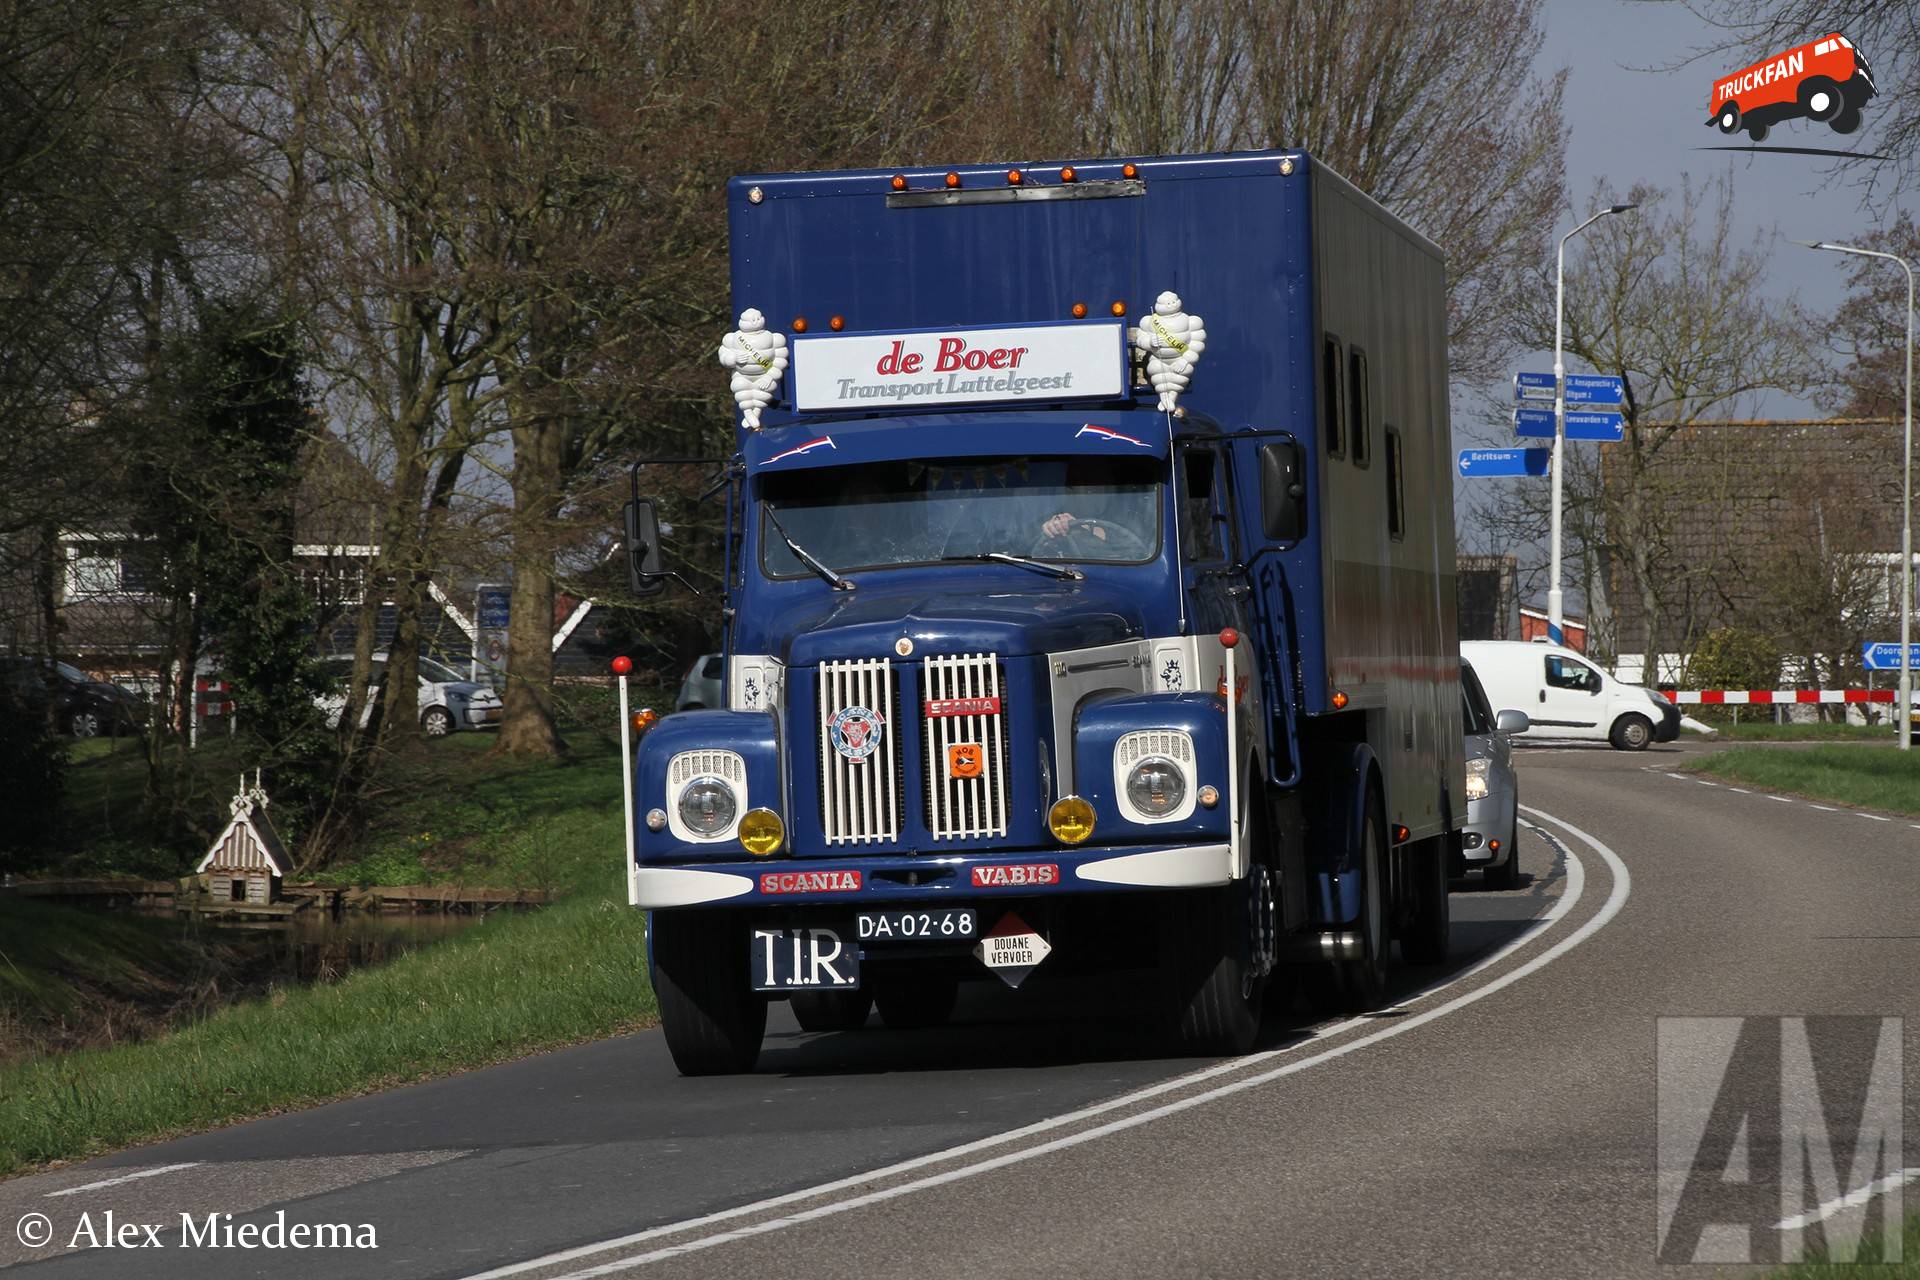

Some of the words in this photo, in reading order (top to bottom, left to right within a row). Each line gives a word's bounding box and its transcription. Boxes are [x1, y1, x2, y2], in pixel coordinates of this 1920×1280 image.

[877, 340, 923, 375] de
[933, 337, 1028, 373] Boer
[837, 373, 945, 401] Transport
[945, 369, 1073, 396] Luttelgeest
[931, 700, 994, 714] SCANIA
[764, 871, 858, 892] SCANIA
[974, 865, 1053, 885] VABIS
[993, 937, 1030, 950] DOUANE
[991, 950, 1034, 964] VERVOER
